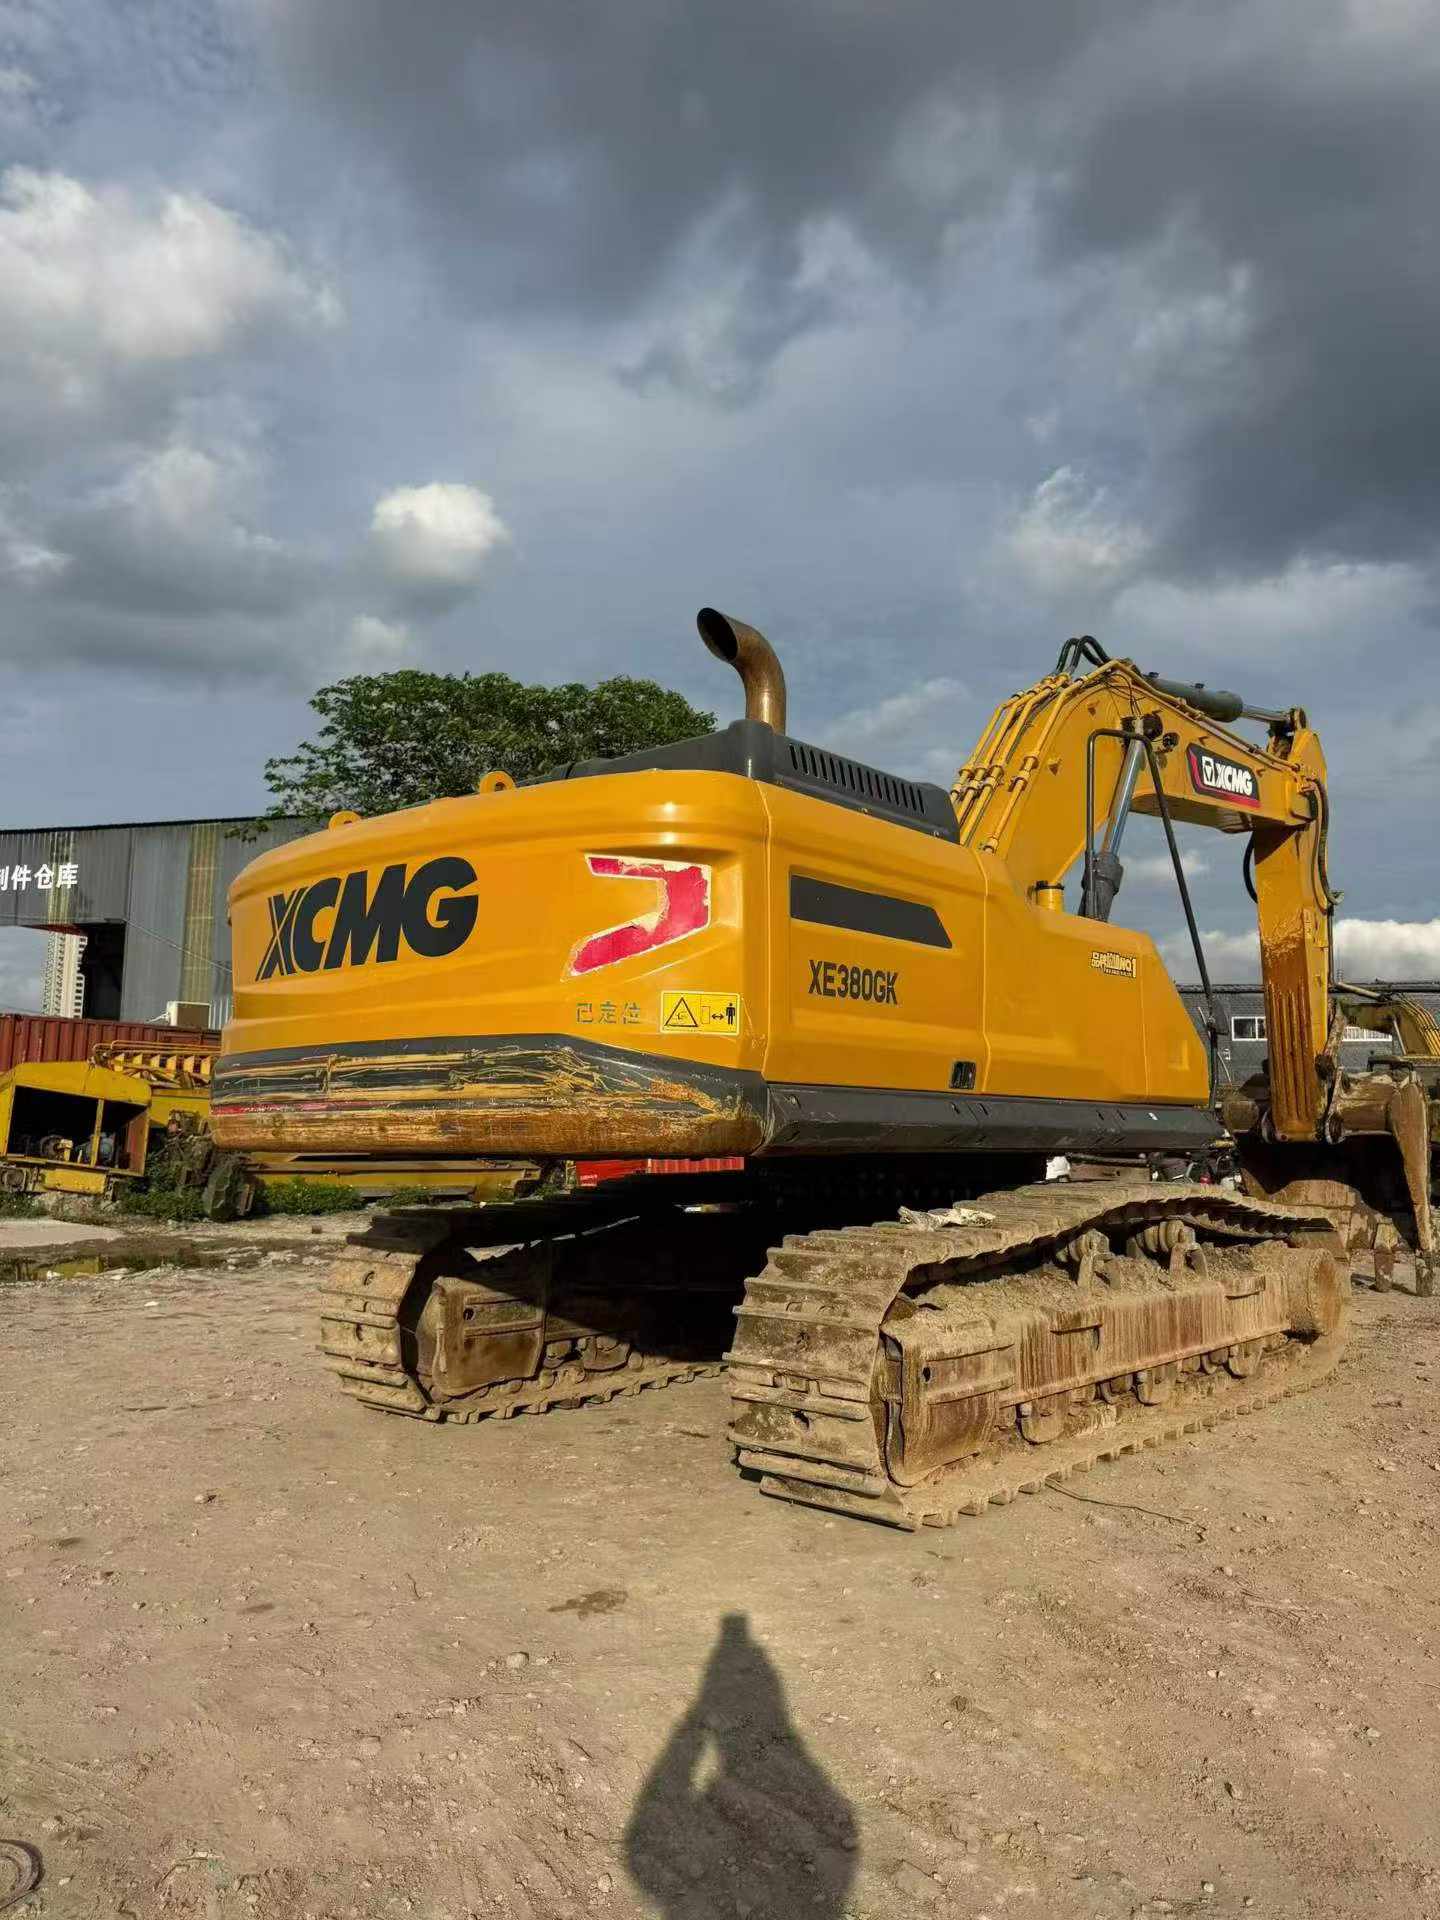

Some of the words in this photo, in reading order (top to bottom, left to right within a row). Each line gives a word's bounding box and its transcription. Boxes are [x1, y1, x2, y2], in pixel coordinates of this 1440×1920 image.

[1216, 762, 1253, 796] XCMG
[255, 856, 479, 982] XCMG
[808, 959, 899, 1005] XE380GK
